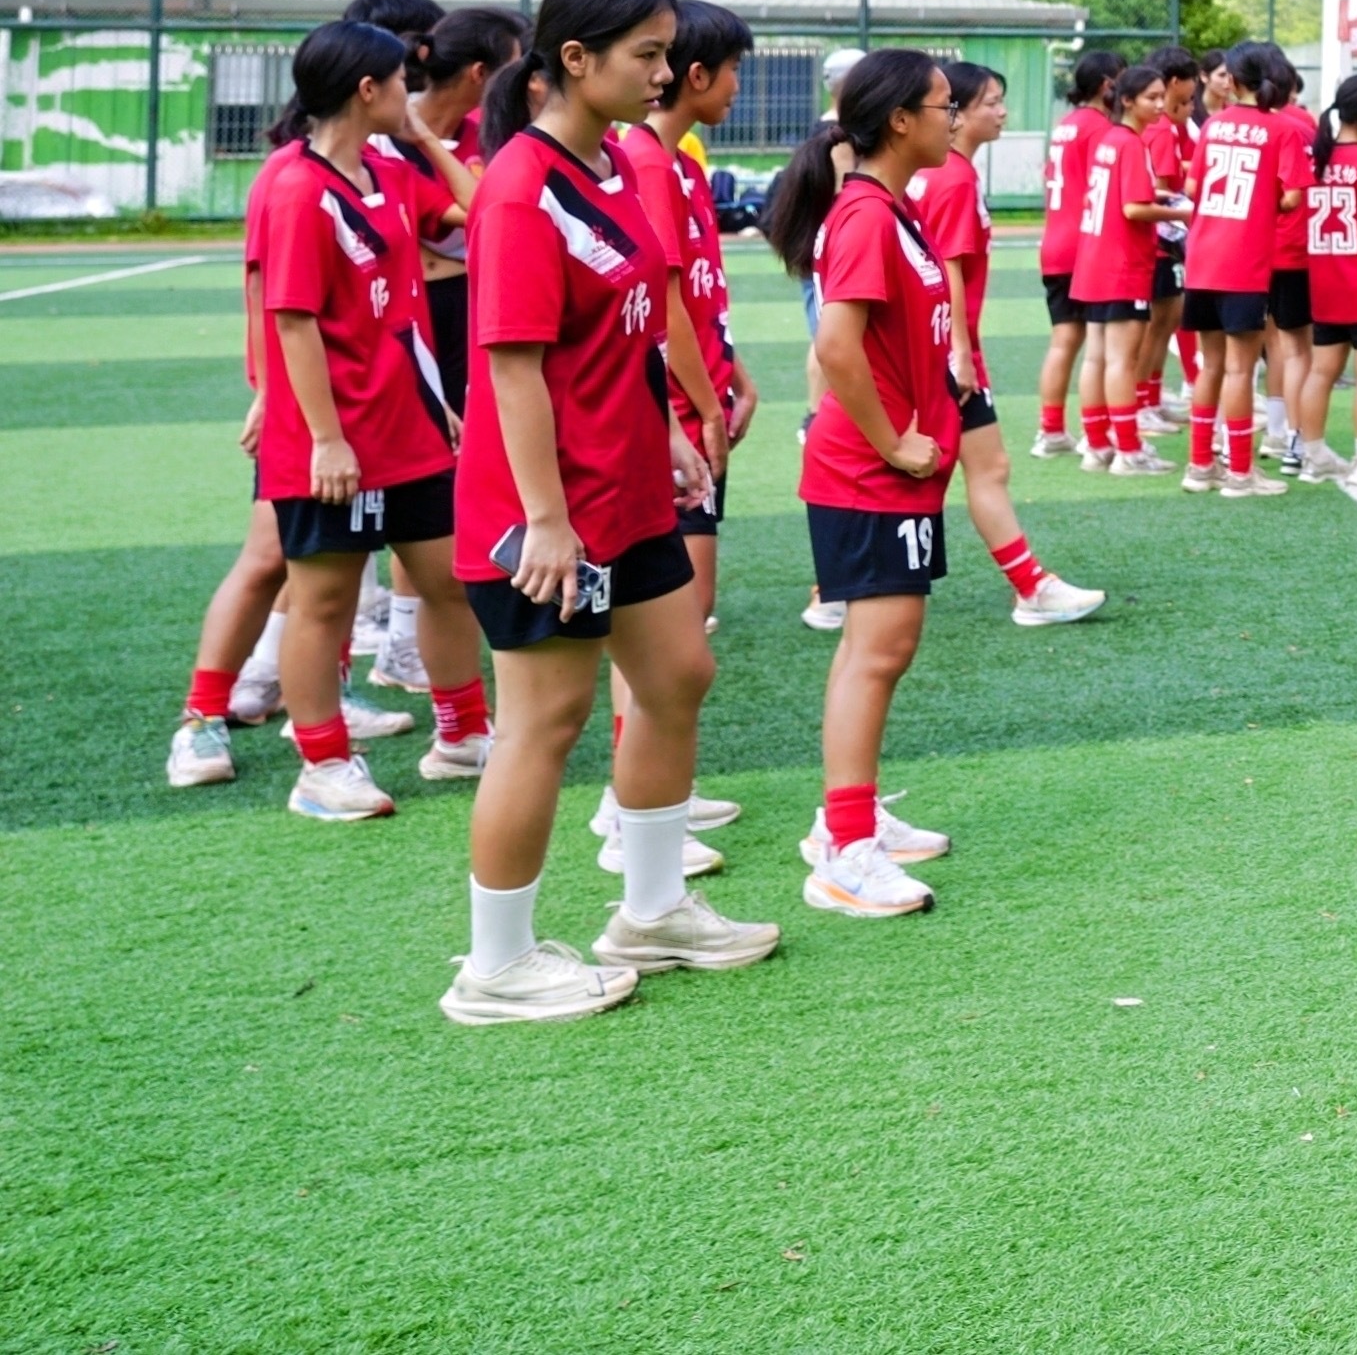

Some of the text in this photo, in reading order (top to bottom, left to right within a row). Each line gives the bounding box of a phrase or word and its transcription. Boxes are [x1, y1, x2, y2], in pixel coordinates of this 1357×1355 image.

[1198, 143, 1262, 221] 26
[350, 488, 386, 533] 14
[897, 516, 934, 571] 19
